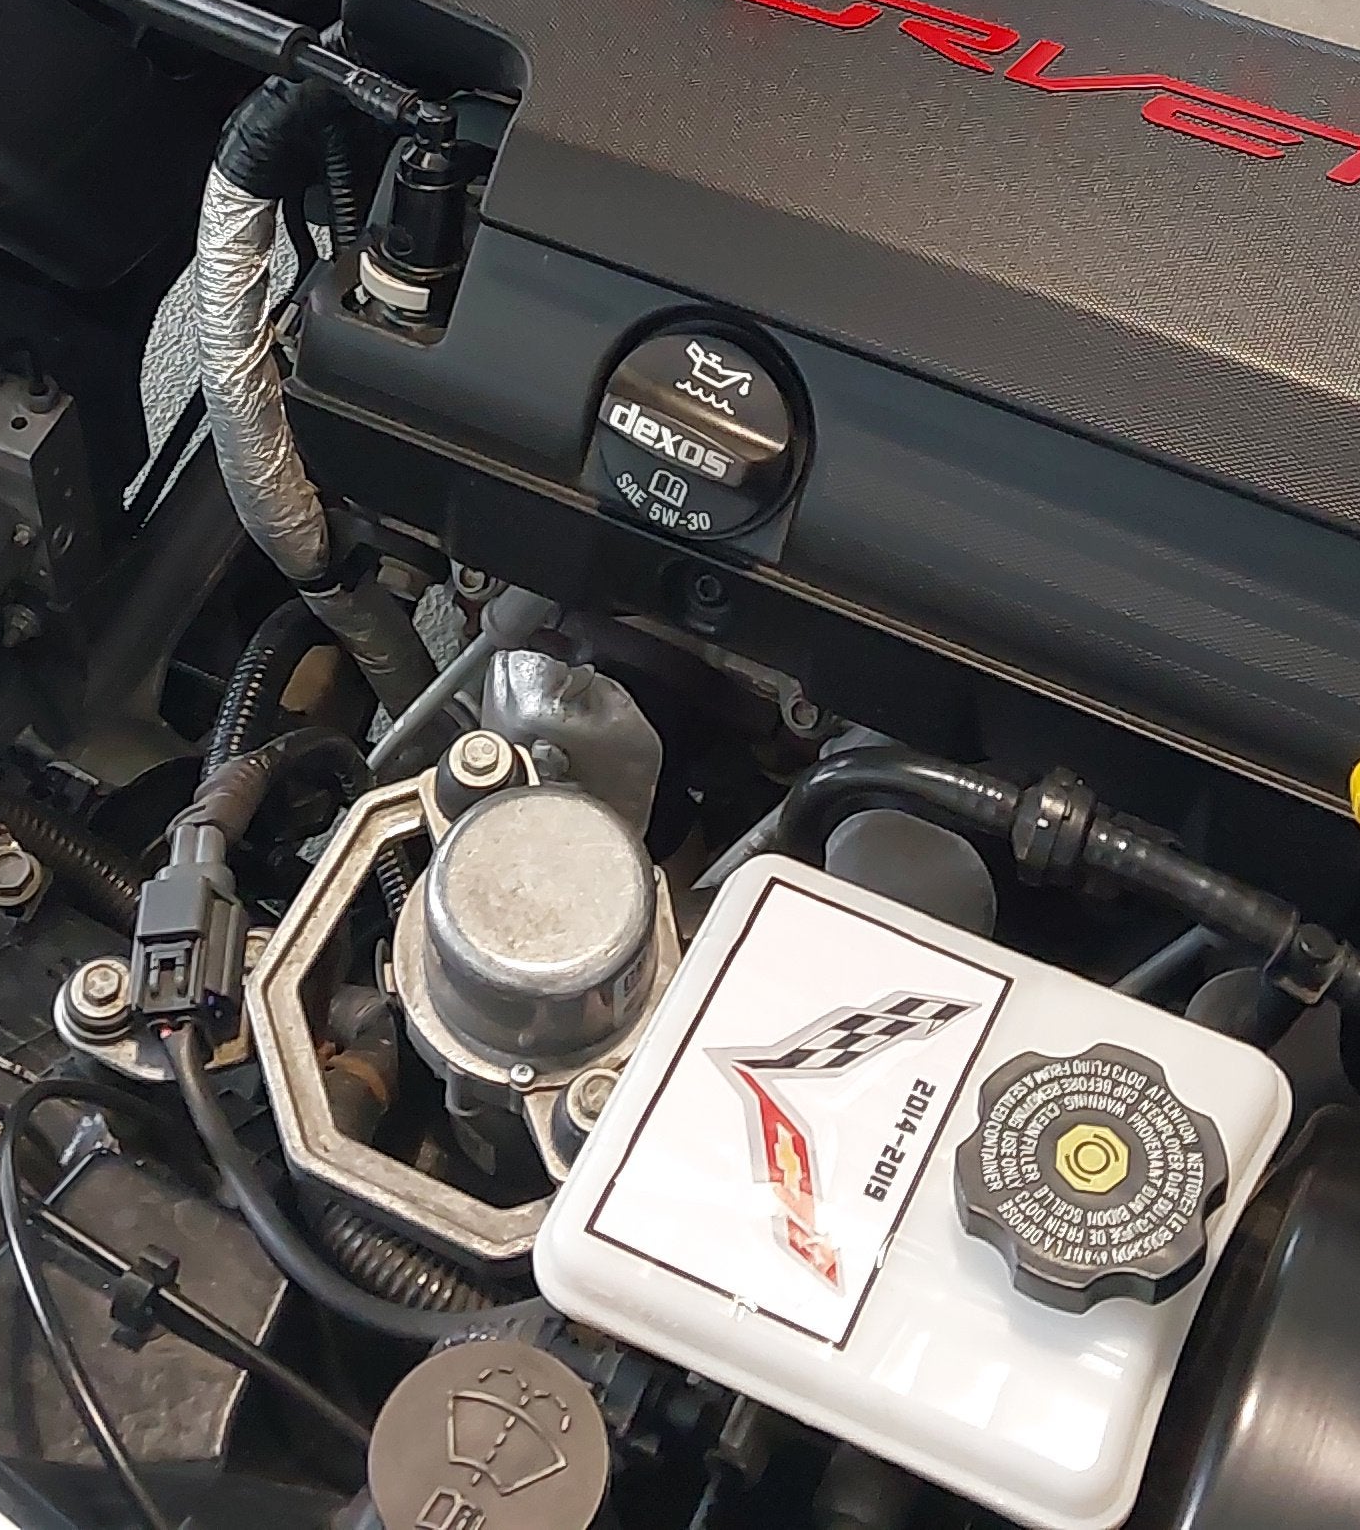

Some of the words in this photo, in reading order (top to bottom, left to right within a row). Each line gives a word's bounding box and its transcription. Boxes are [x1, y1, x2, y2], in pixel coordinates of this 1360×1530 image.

[609, 403, 733, 478] dexos
[616, 472, 646, 508] SAE
[648, 502, 711, 532] 5W-30
[1113, 1082, 1139, 1104] CAP
[863, 1078, 936, 1201] 2014-2019
